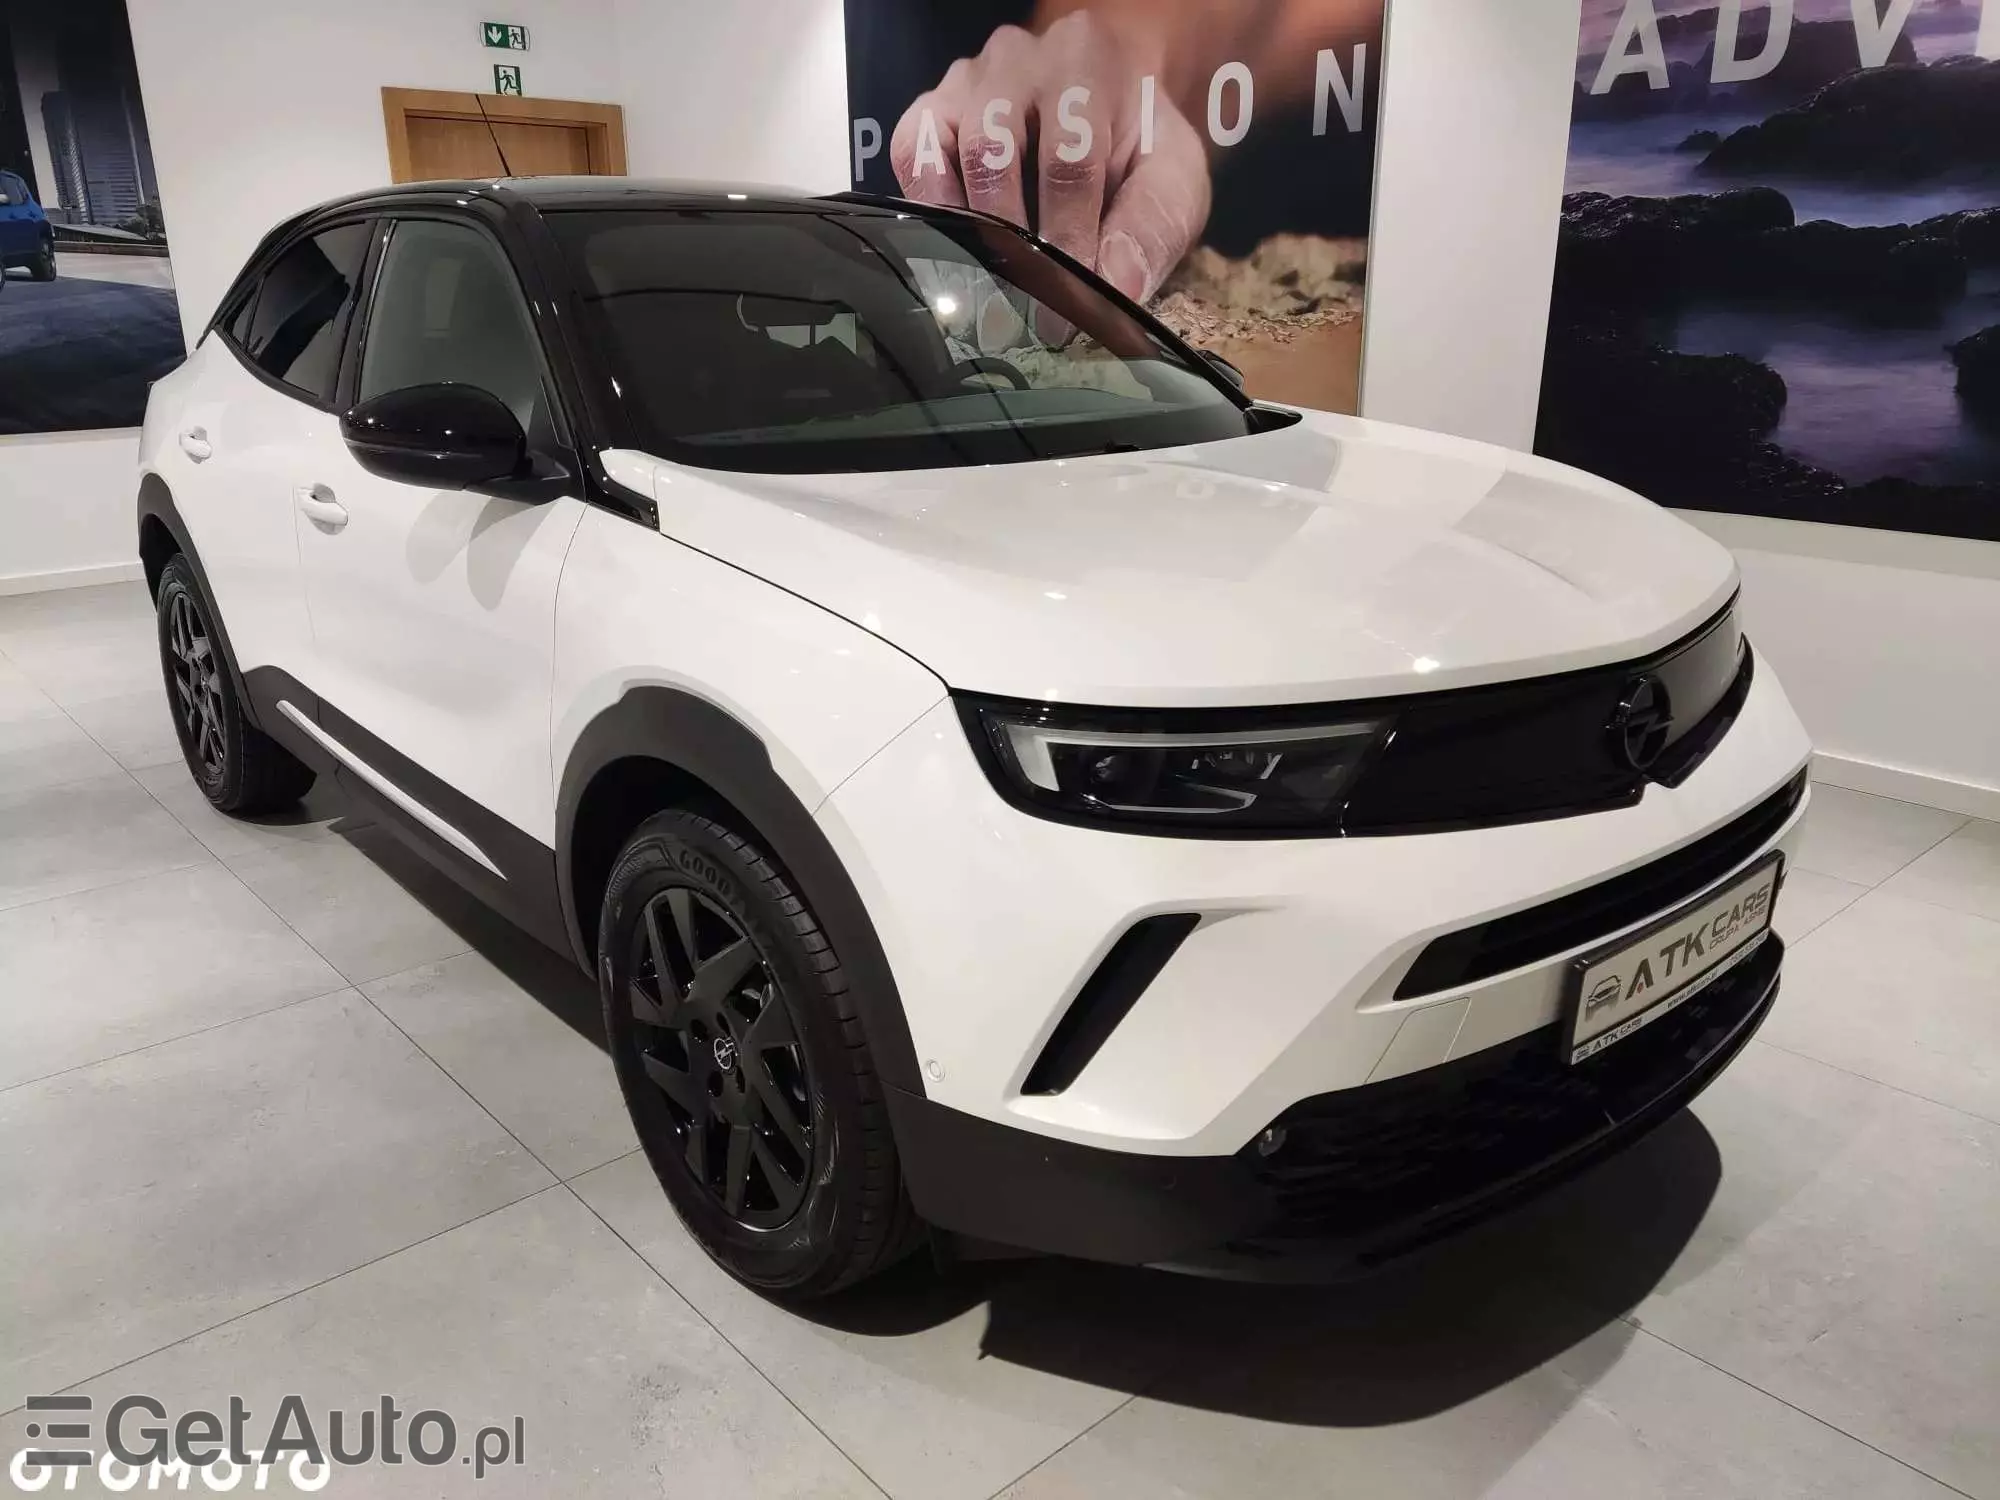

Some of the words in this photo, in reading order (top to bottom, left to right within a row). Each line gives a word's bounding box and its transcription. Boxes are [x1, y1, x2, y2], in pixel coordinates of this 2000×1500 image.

[853, 42, 1367, 183] PASSION
[1625, 921, 1710, 1001] ATK
[1711, 882, 1771, 938] CARS
